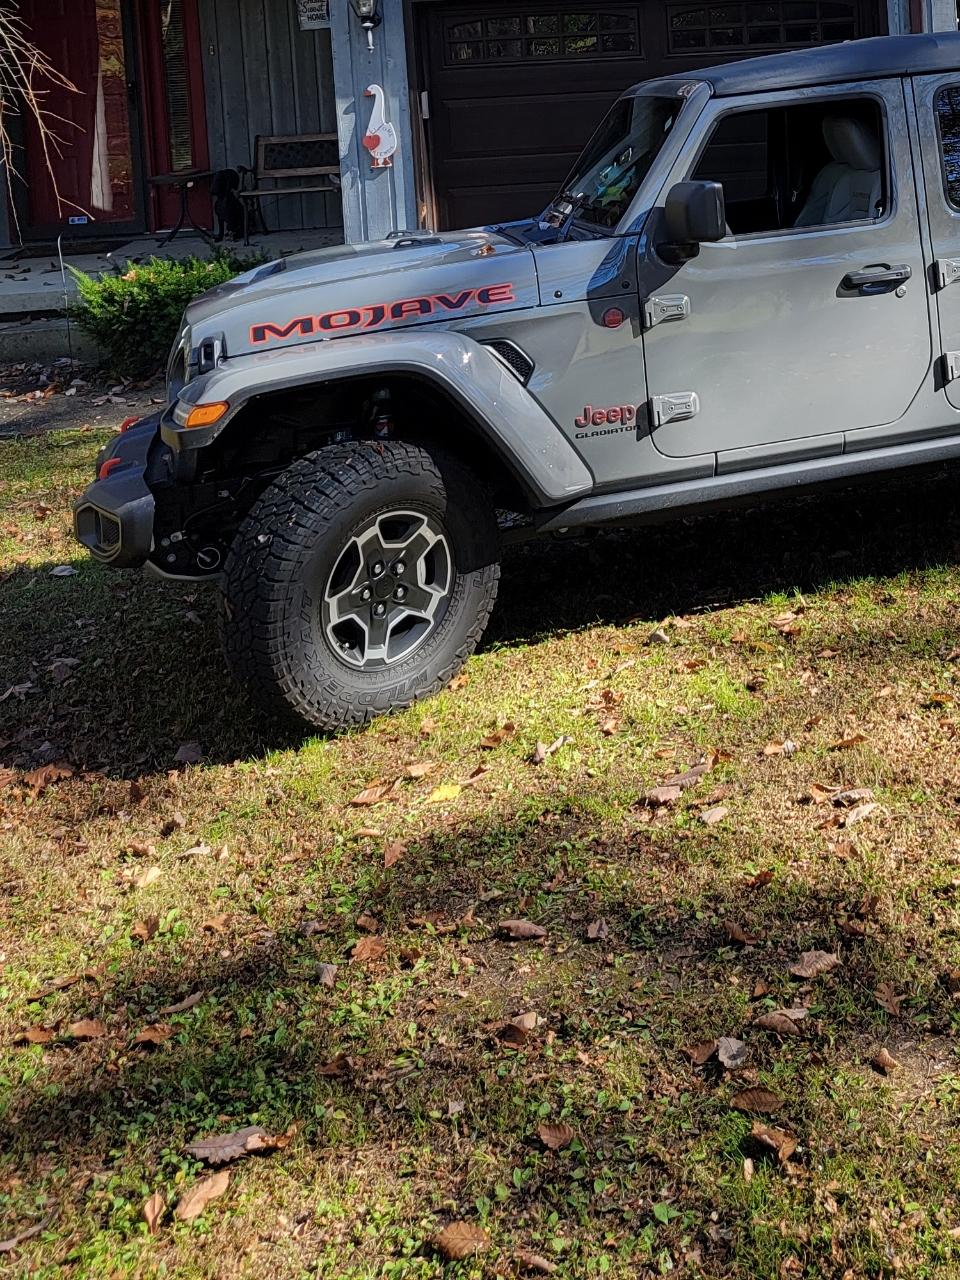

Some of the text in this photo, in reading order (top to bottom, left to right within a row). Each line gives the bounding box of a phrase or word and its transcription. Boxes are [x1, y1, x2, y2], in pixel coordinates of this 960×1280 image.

[307, 12, 327, 21] HOME
[249, 282, 515, 345] MOJAVE
[574, 403, 636, 428] Jeep
